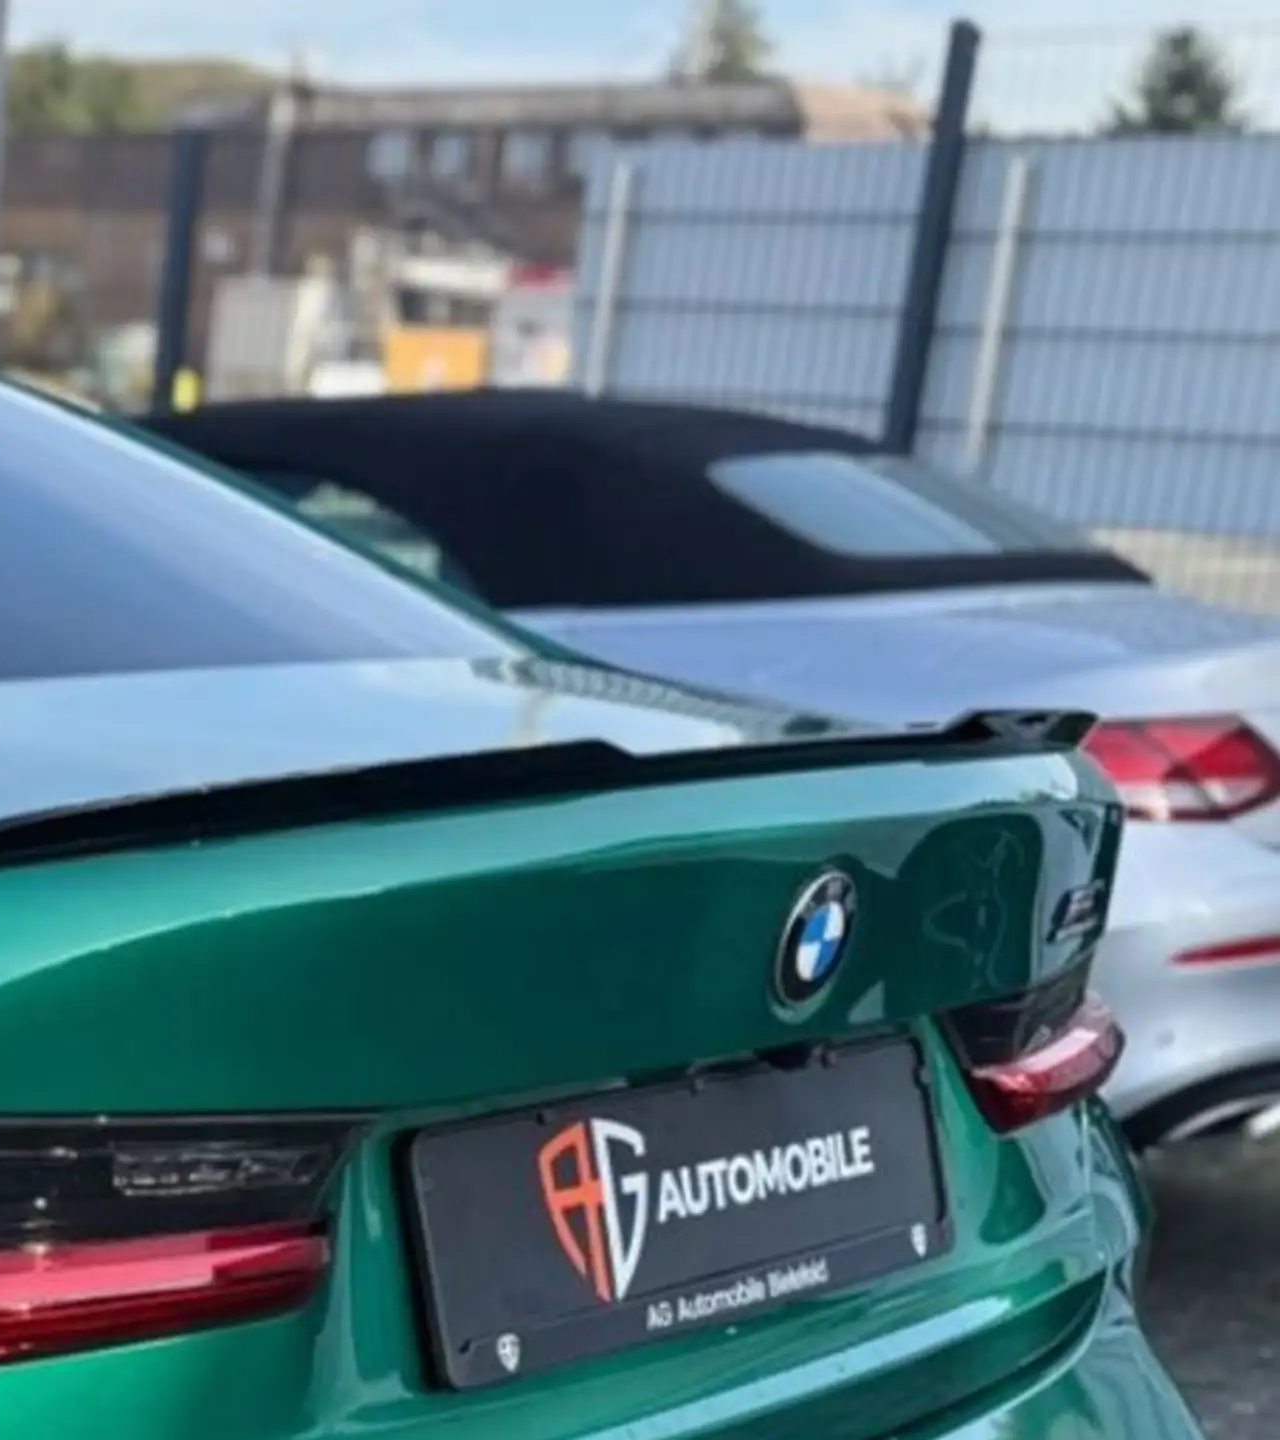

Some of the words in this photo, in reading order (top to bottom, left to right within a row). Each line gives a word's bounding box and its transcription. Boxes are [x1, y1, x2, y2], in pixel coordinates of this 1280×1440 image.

[539, 1117, 649, 1302] AG
[657, 1126, 875, 1223] AUTOMOBILE
[646, 1301, 673, 1331] AG
[677, 1276, 766, 1322] Automobile
[766, 1256, 830, 1298] Bielefeld
